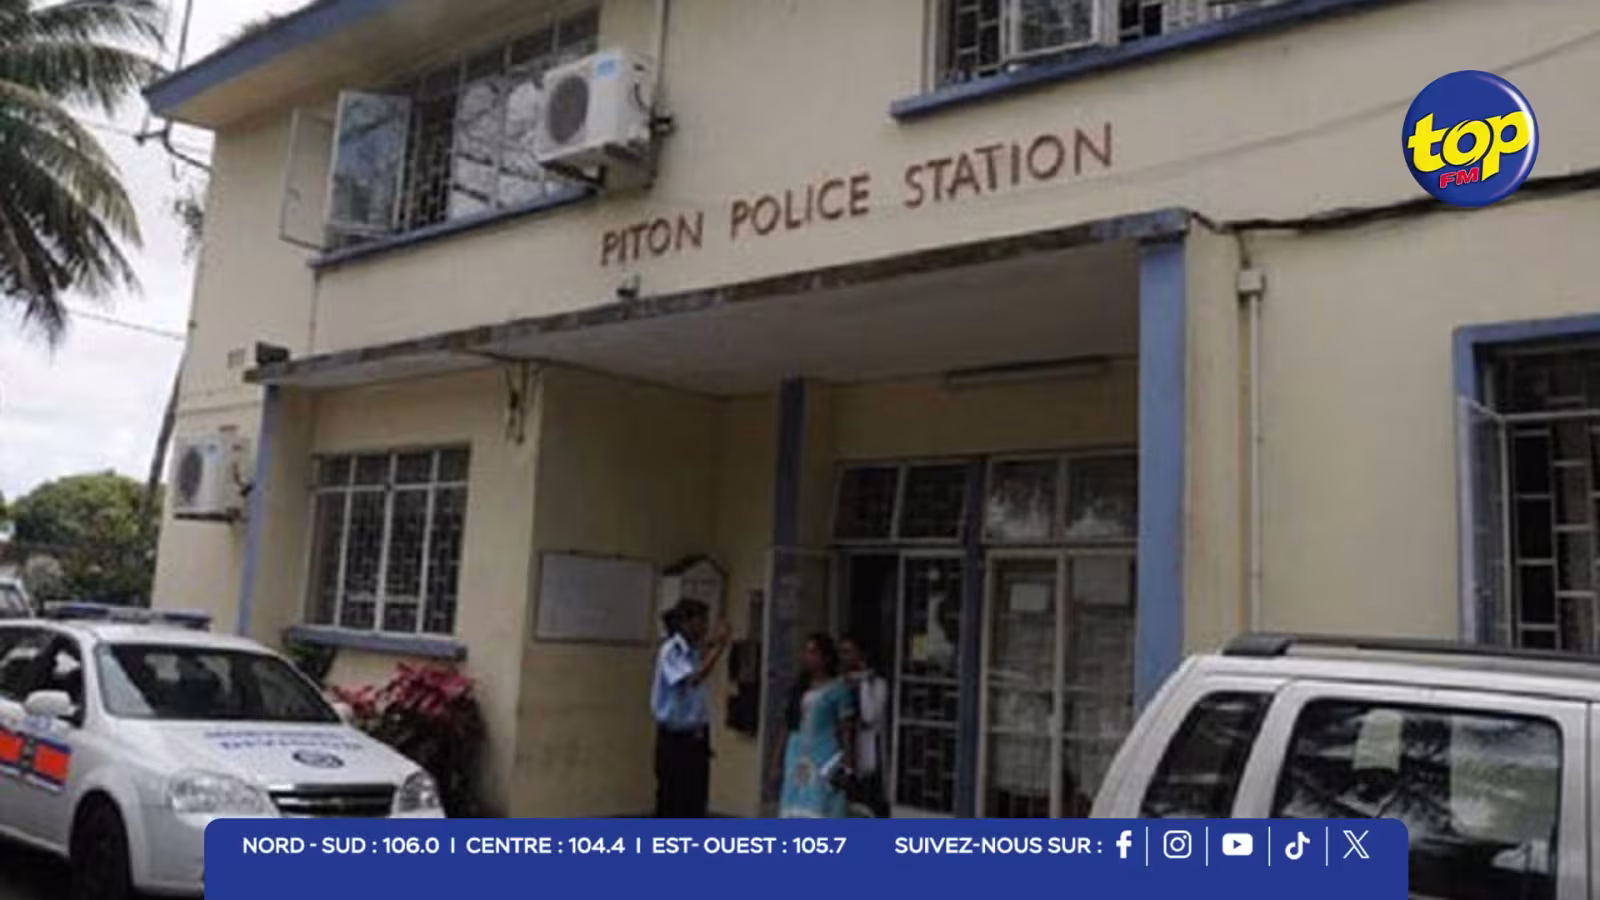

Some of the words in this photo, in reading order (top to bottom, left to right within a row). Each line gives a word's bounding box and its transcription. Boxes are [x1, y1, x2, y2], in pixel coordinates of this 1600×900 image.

[600, 211, 704, 267] PITON
[730, 174, 870, 240] POLICE
[904, 122, 1113, 209] STATION
